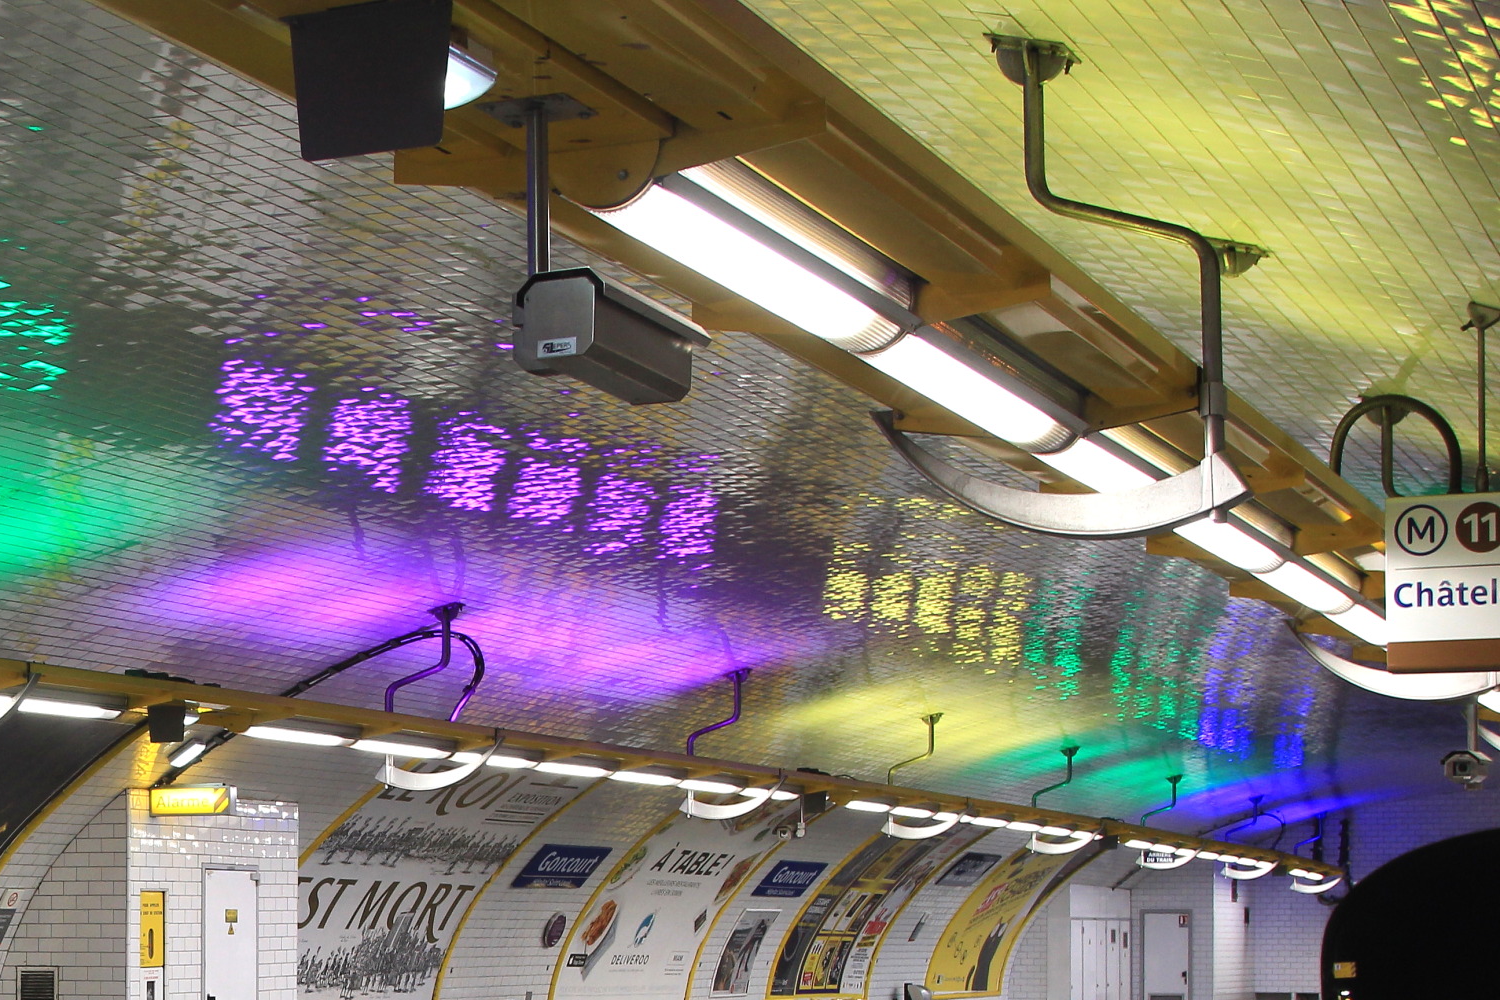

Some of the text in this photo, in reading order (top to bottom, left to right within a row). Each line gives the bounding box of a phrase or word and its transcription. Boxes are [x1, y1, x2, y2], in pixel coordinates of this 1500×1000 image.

[1407, 512, 1496, 545] M 11
[1393, 578, 1497, 608] Châtel
[156, 796, 210, 808] Alarme
[507, 792, 562, 806] EXPOSITION
[538, 851, 599, 873] Goncourt
[772, 866, 818, 885] Goncourt
[345, 881, 476, 943] MORT
[611, 955, 650, 965] DELIVEROO
